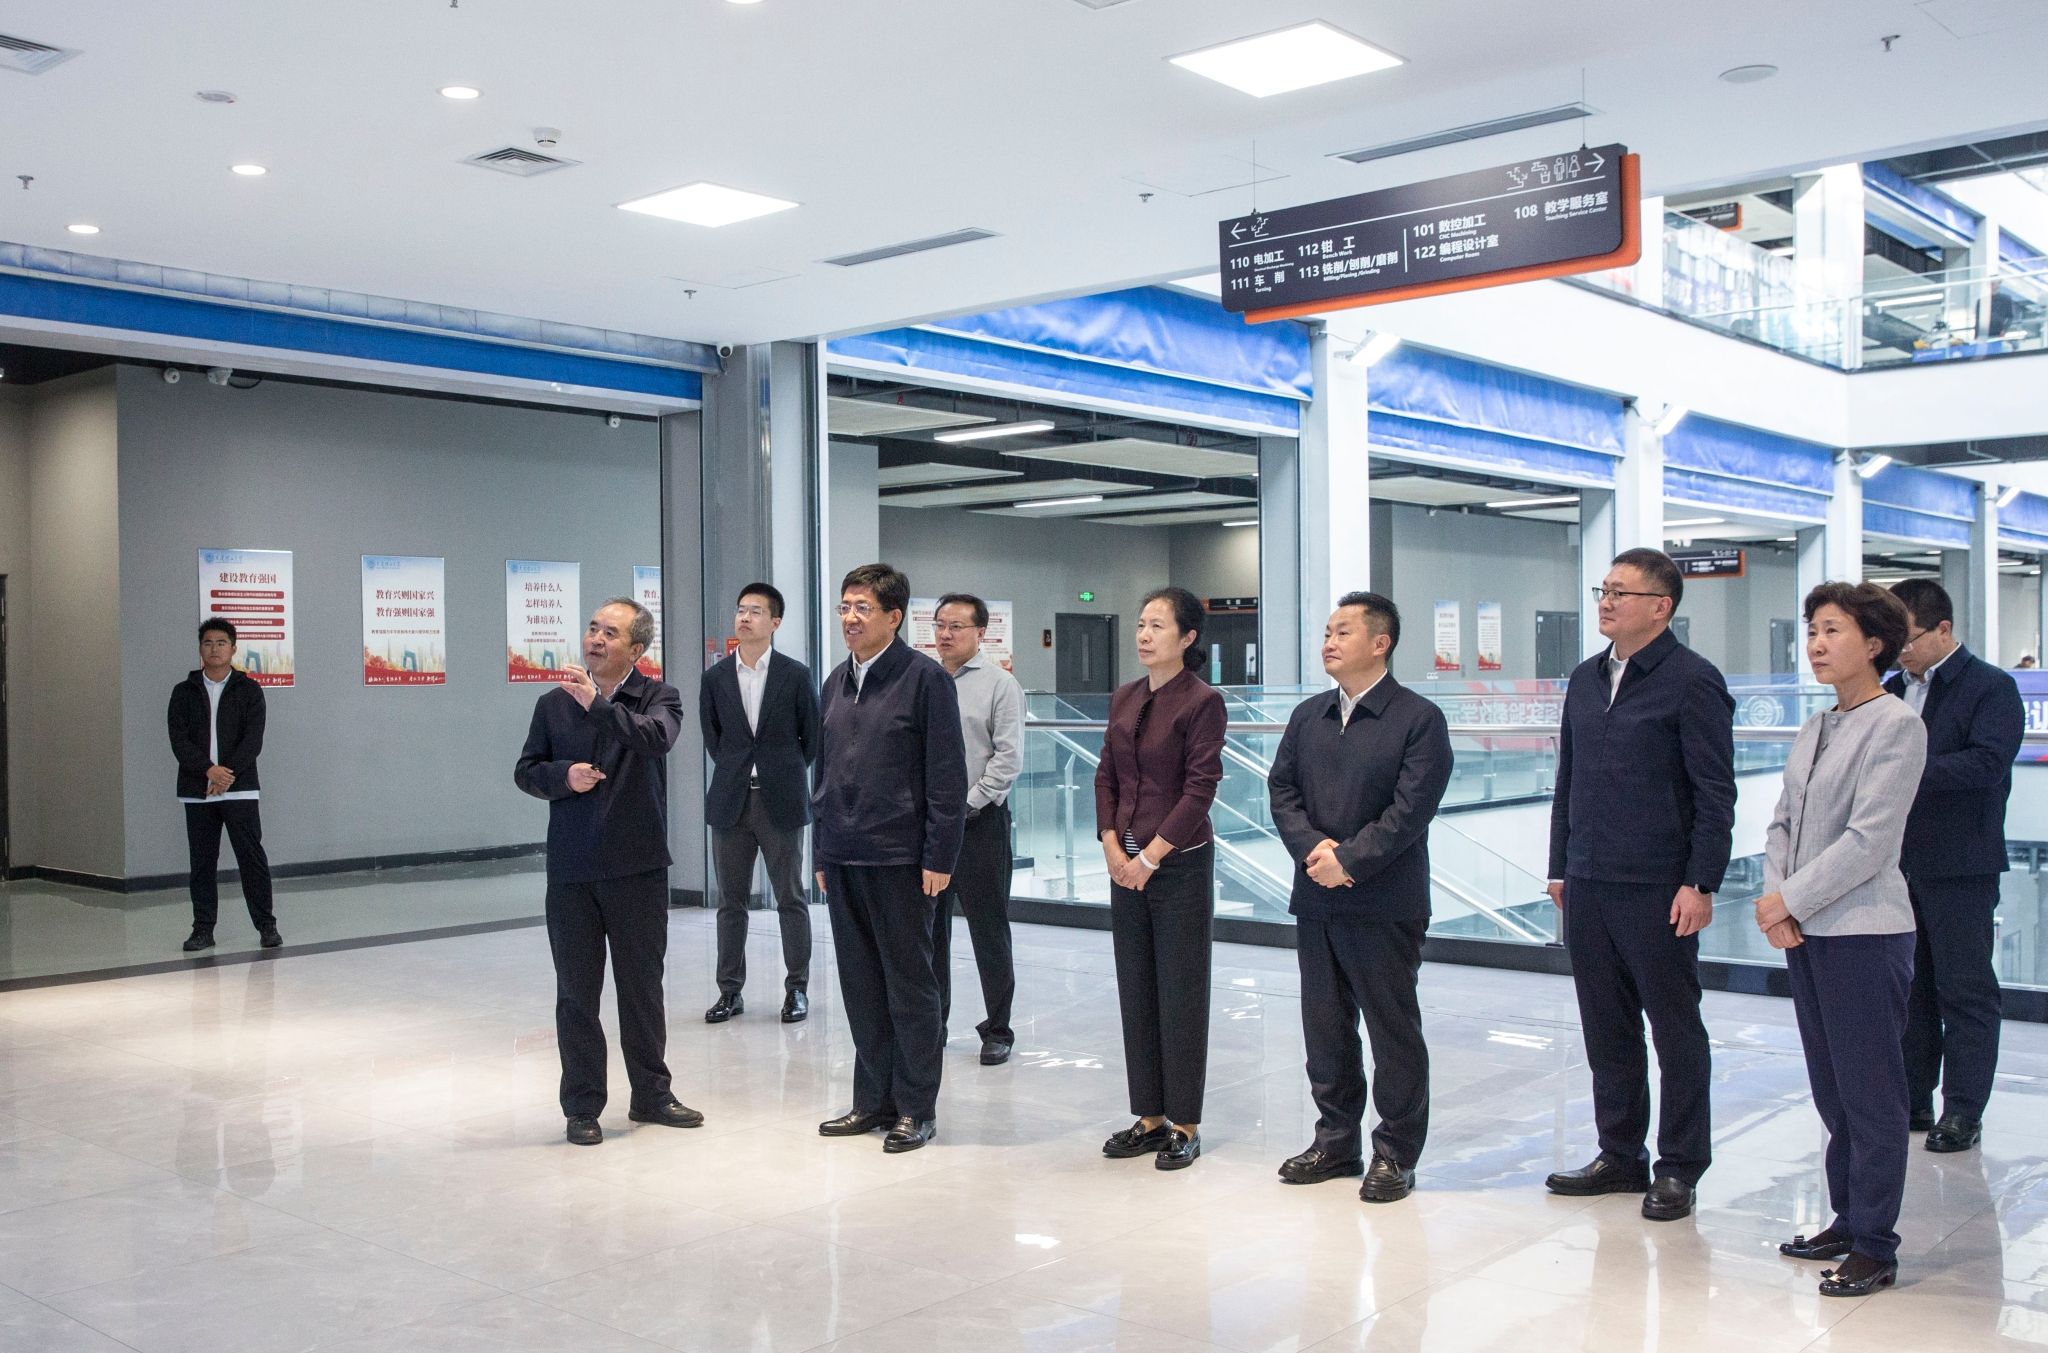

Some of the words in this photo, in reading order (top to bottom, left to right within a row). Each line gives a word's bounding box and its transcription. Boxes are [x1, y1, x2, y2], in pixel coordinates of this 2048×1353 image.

[1514, 204, 1538, 220] 108
[1543, 191, 1609, 215] 教学服务室
[1569, 208, 1589, 219] Service
[1589, 204, 1607, 215] Center
[1413, 223, 1434, 238] 101
[1438, 214, 1487, 234] 数控加工
[1439, 231, 1451, 240] CNC
[1298, 243, 1319, 257] 112
[1413, 245, 1437, 260] 122
[1438, 234, 1499, 256] 编程设计室
[1230, 256, 1249, 270] 110
[1253, 249, 1285, 266] 电加工
[1322, 251, 1338, 260] Bench
[1338, 249, 1353, 257] Work
[1439, 253, 1464, 263] Computer
[1465, 251, 1480, 259] Room
[1299, 265, 1319, 279] 113
[1322, 250, 1398, 276] 铣削/刨削/磨削
[1231, 277, 1249, 290] 111
[219, 572, 277, 584] 建设教育强国
[524, 582, 563, 592] 培养什么人
[375, 590, 435, 600] 教育兴则国家兴
[525, 598, 563, 608] 怎样培养人
[375, 607, 435, 617] 教育强则国家强
[525, 615, 563, 625] 为谁培养人
